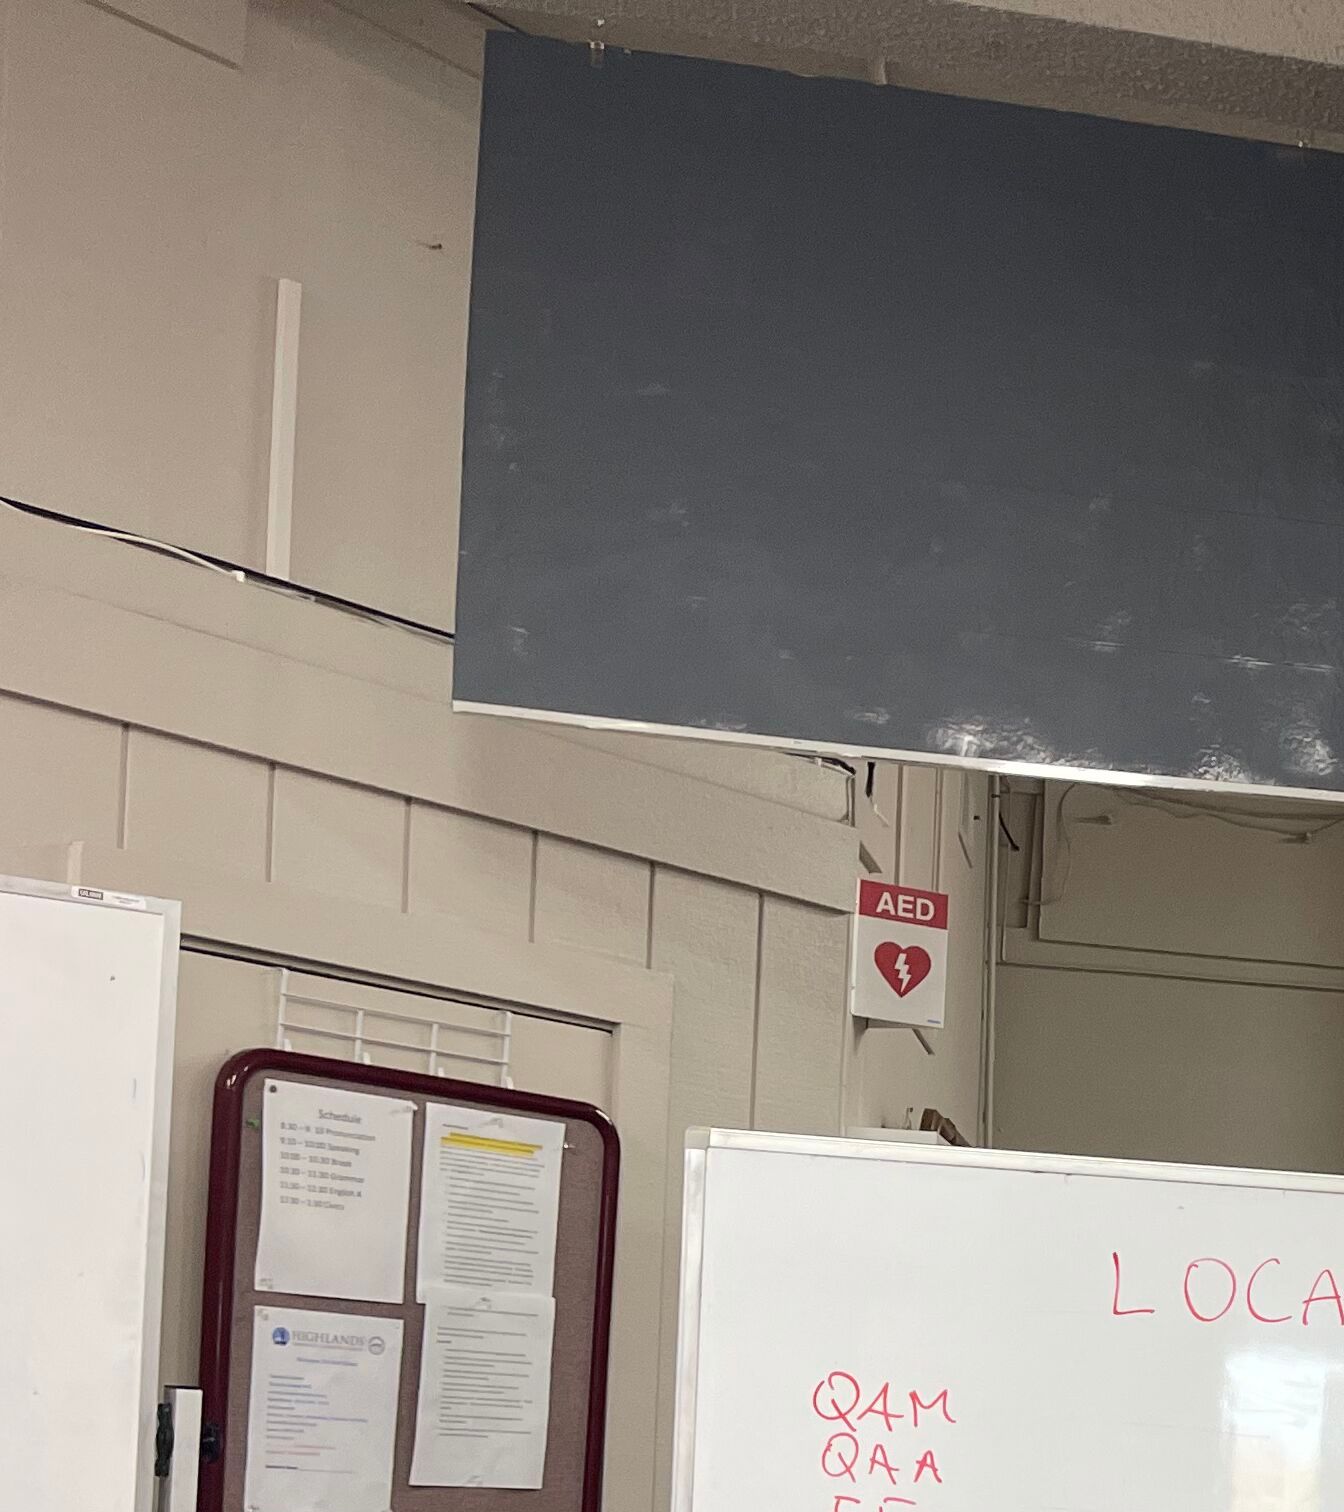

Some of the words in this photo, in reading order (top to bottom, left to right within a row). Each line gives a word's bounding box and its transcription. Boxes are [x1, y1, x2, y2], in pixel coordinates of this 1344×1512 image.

[875, 891, 935, 921] AED
[319, 1109, 362, 1124] Schedule
[812, 1371, 956, 1432] QAM
[821, 1432, 943, 1485] QAA
